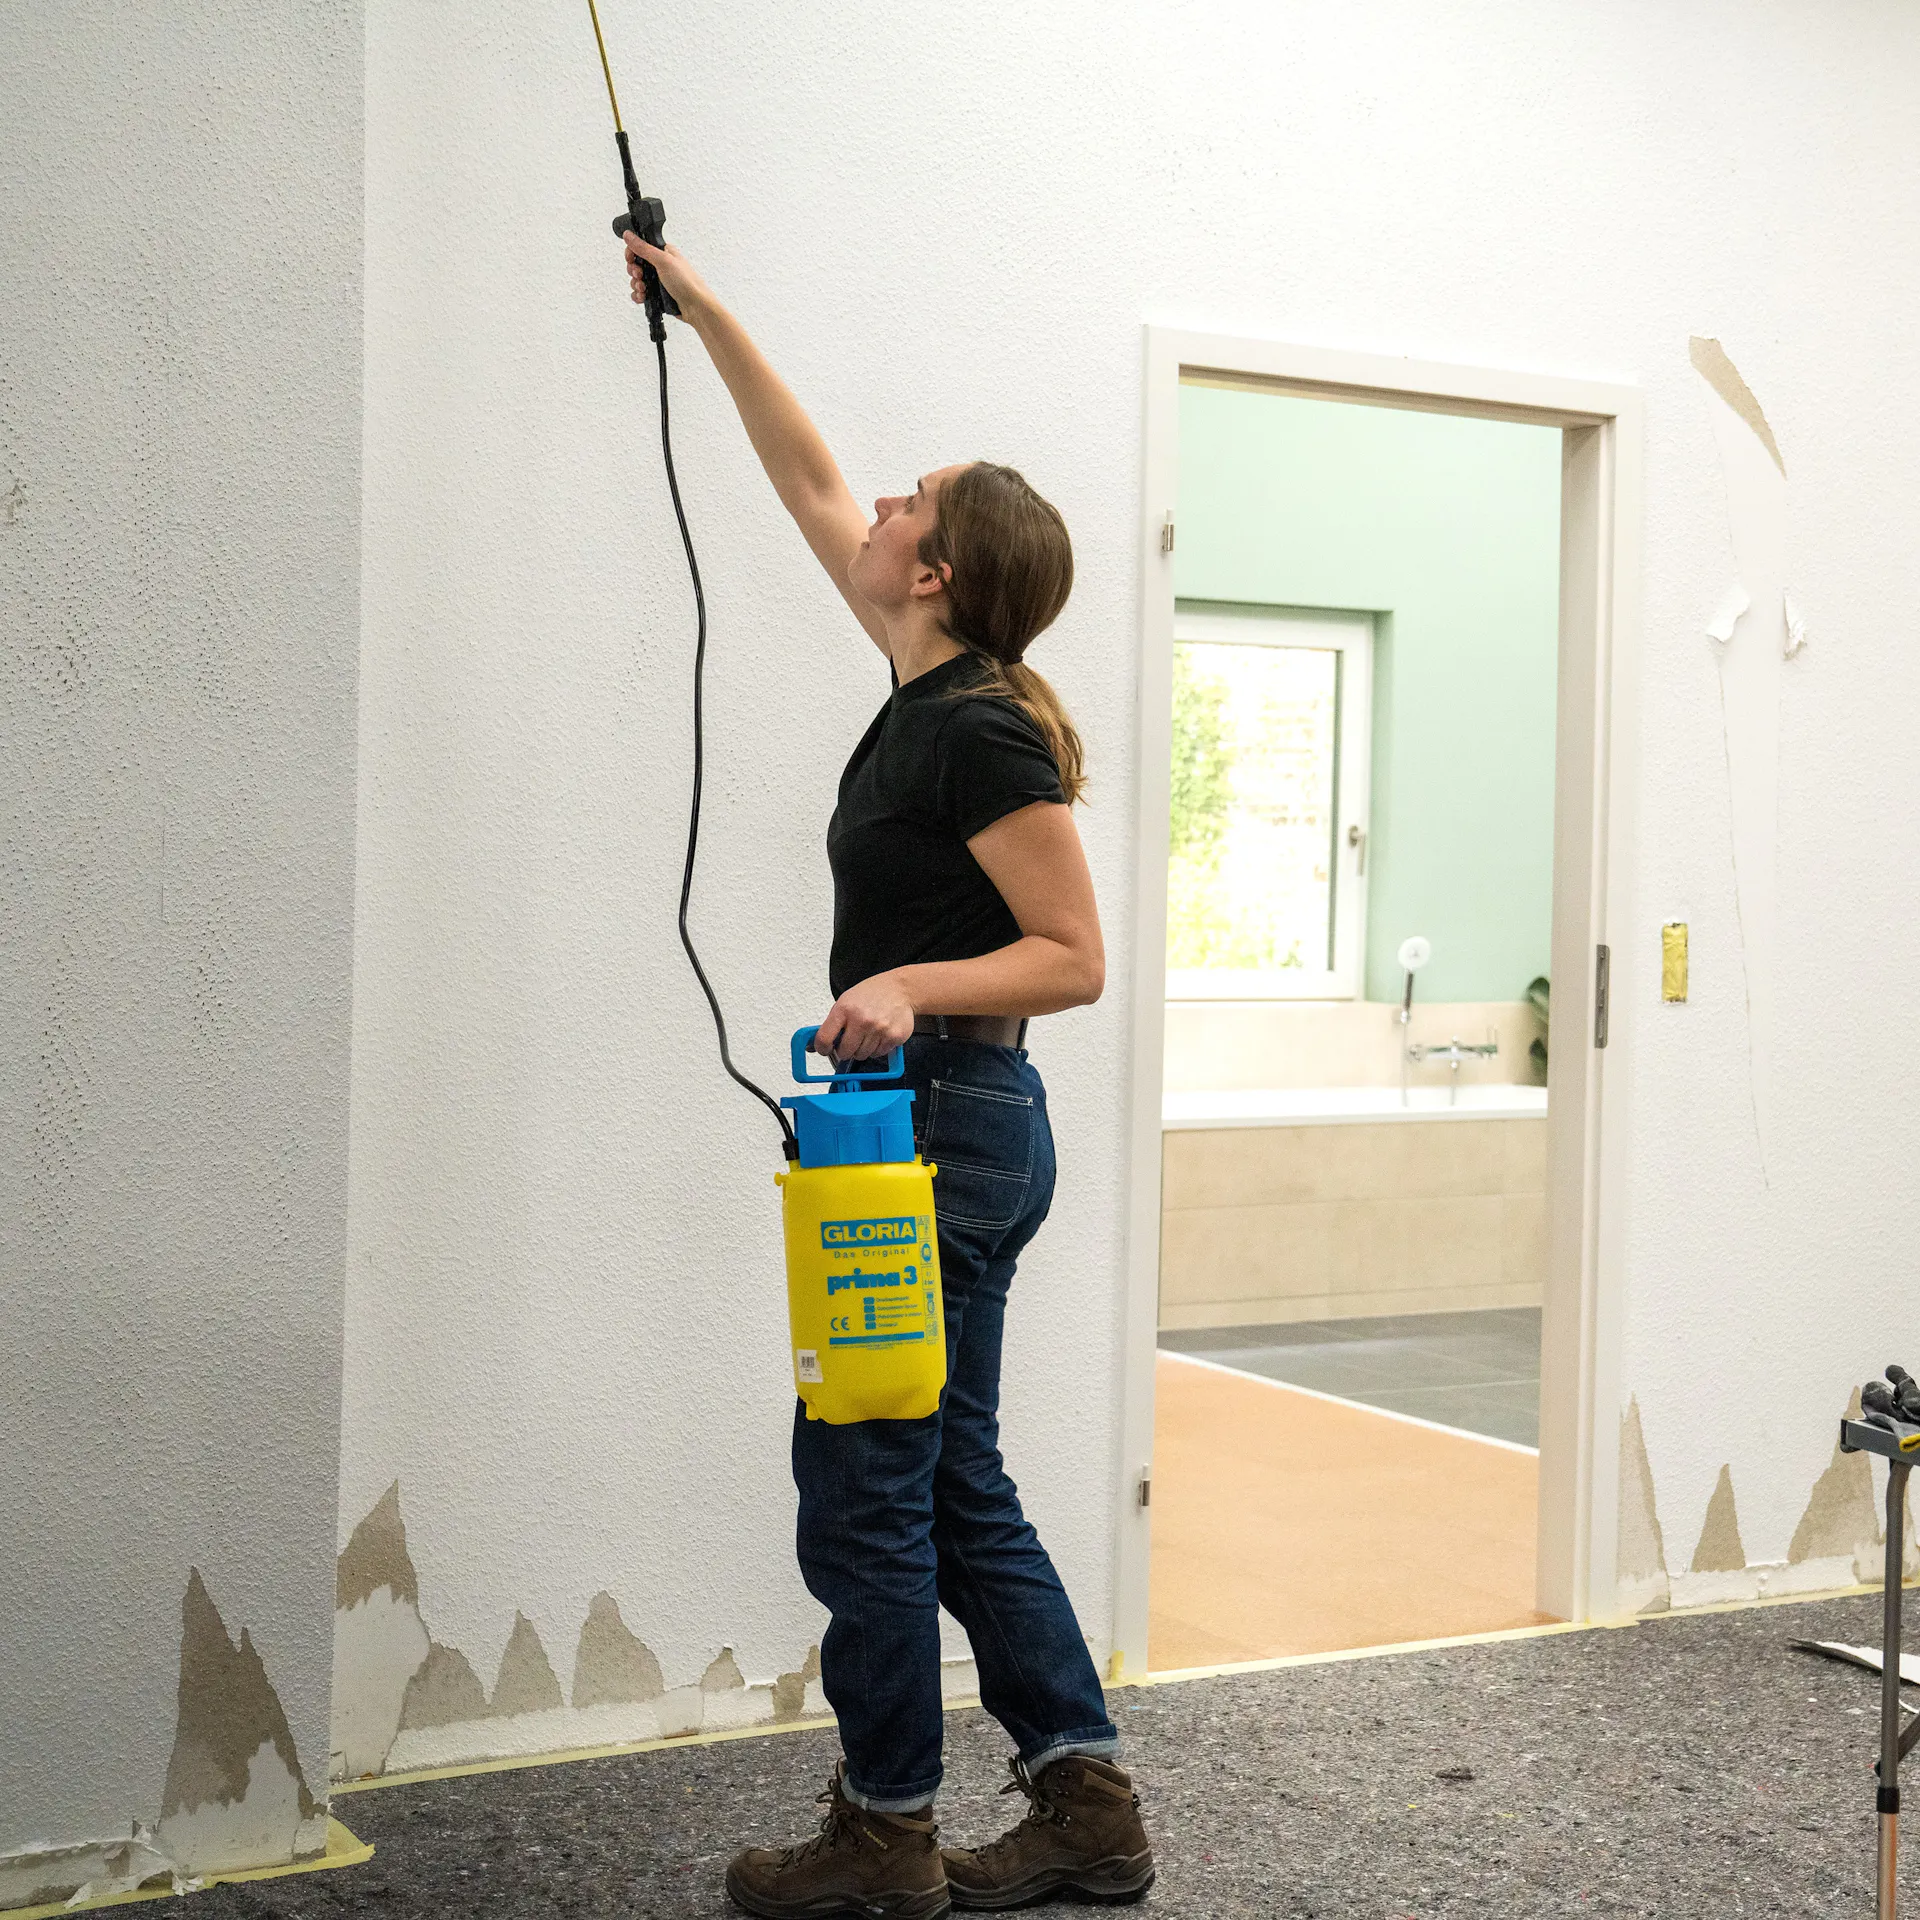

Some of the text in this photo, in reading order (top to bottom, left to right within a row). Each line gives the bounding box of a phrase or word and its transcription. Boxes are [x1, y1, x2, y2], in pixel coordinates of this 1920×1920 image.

[823, 1222, 915, 1243] GLORIA
[834, 1248, 910, 1259] Das Original
[827, 1265, 918, 1296] prima 3
[830, 1316, 850, 1331] CE
